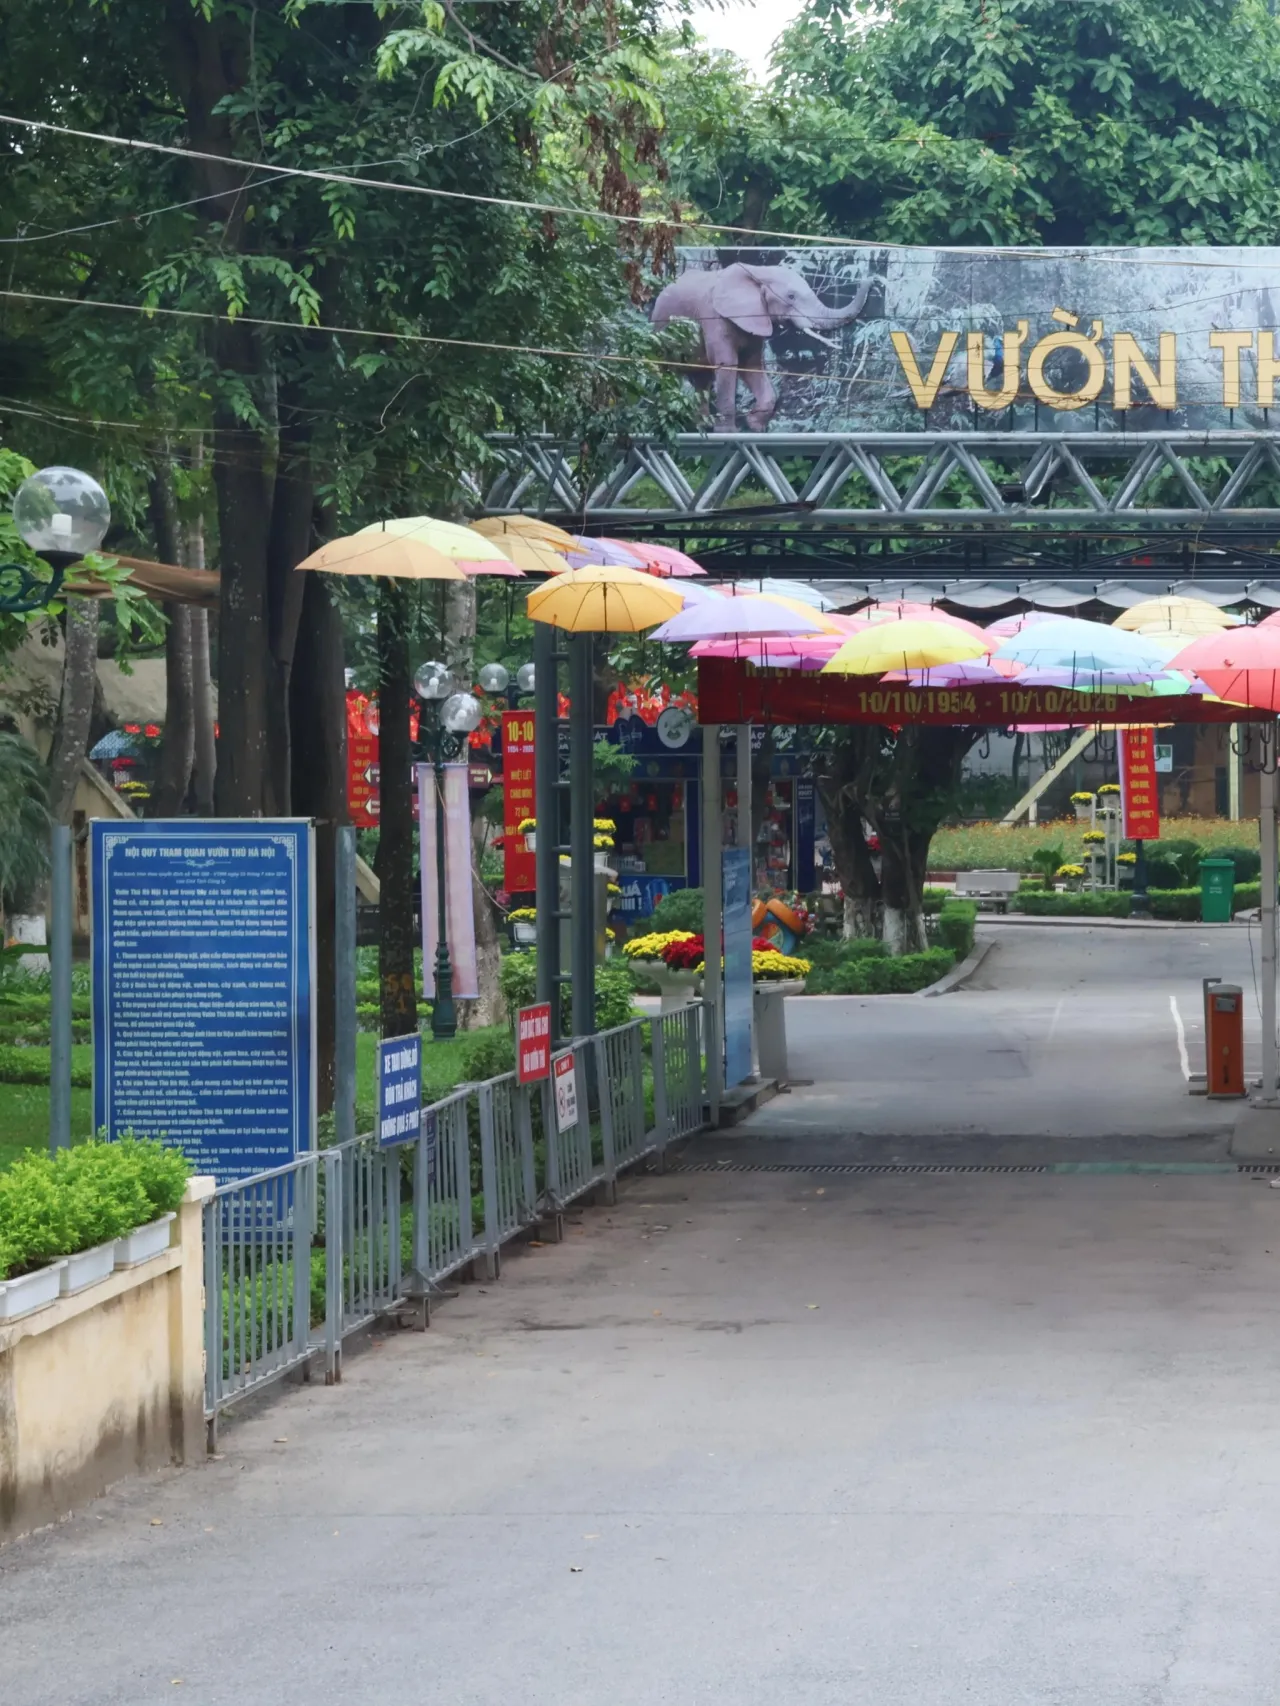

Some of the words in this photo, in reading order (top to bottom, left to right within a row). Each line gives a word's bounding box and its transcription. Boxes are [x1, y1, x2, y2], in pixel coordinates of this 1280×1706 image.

[890, 305, 1176, 411] VƯỜN
[858, 690, 976, 714] 10/10/1954
[507, 720, 534, 742] 10-10
[125, 846, 140, 859] NỘI
[141, 847, 157, 857] QUY
[160, 847, 182, 857] THAM
[184, 847, 206, 858] QUAN
[208, 845, 229, 857] VƯỜN
[231, 846, 246, 857] THÚ
[248, 846, 259, 857] HÀ
[261, 846, 275, 859] NỘI
